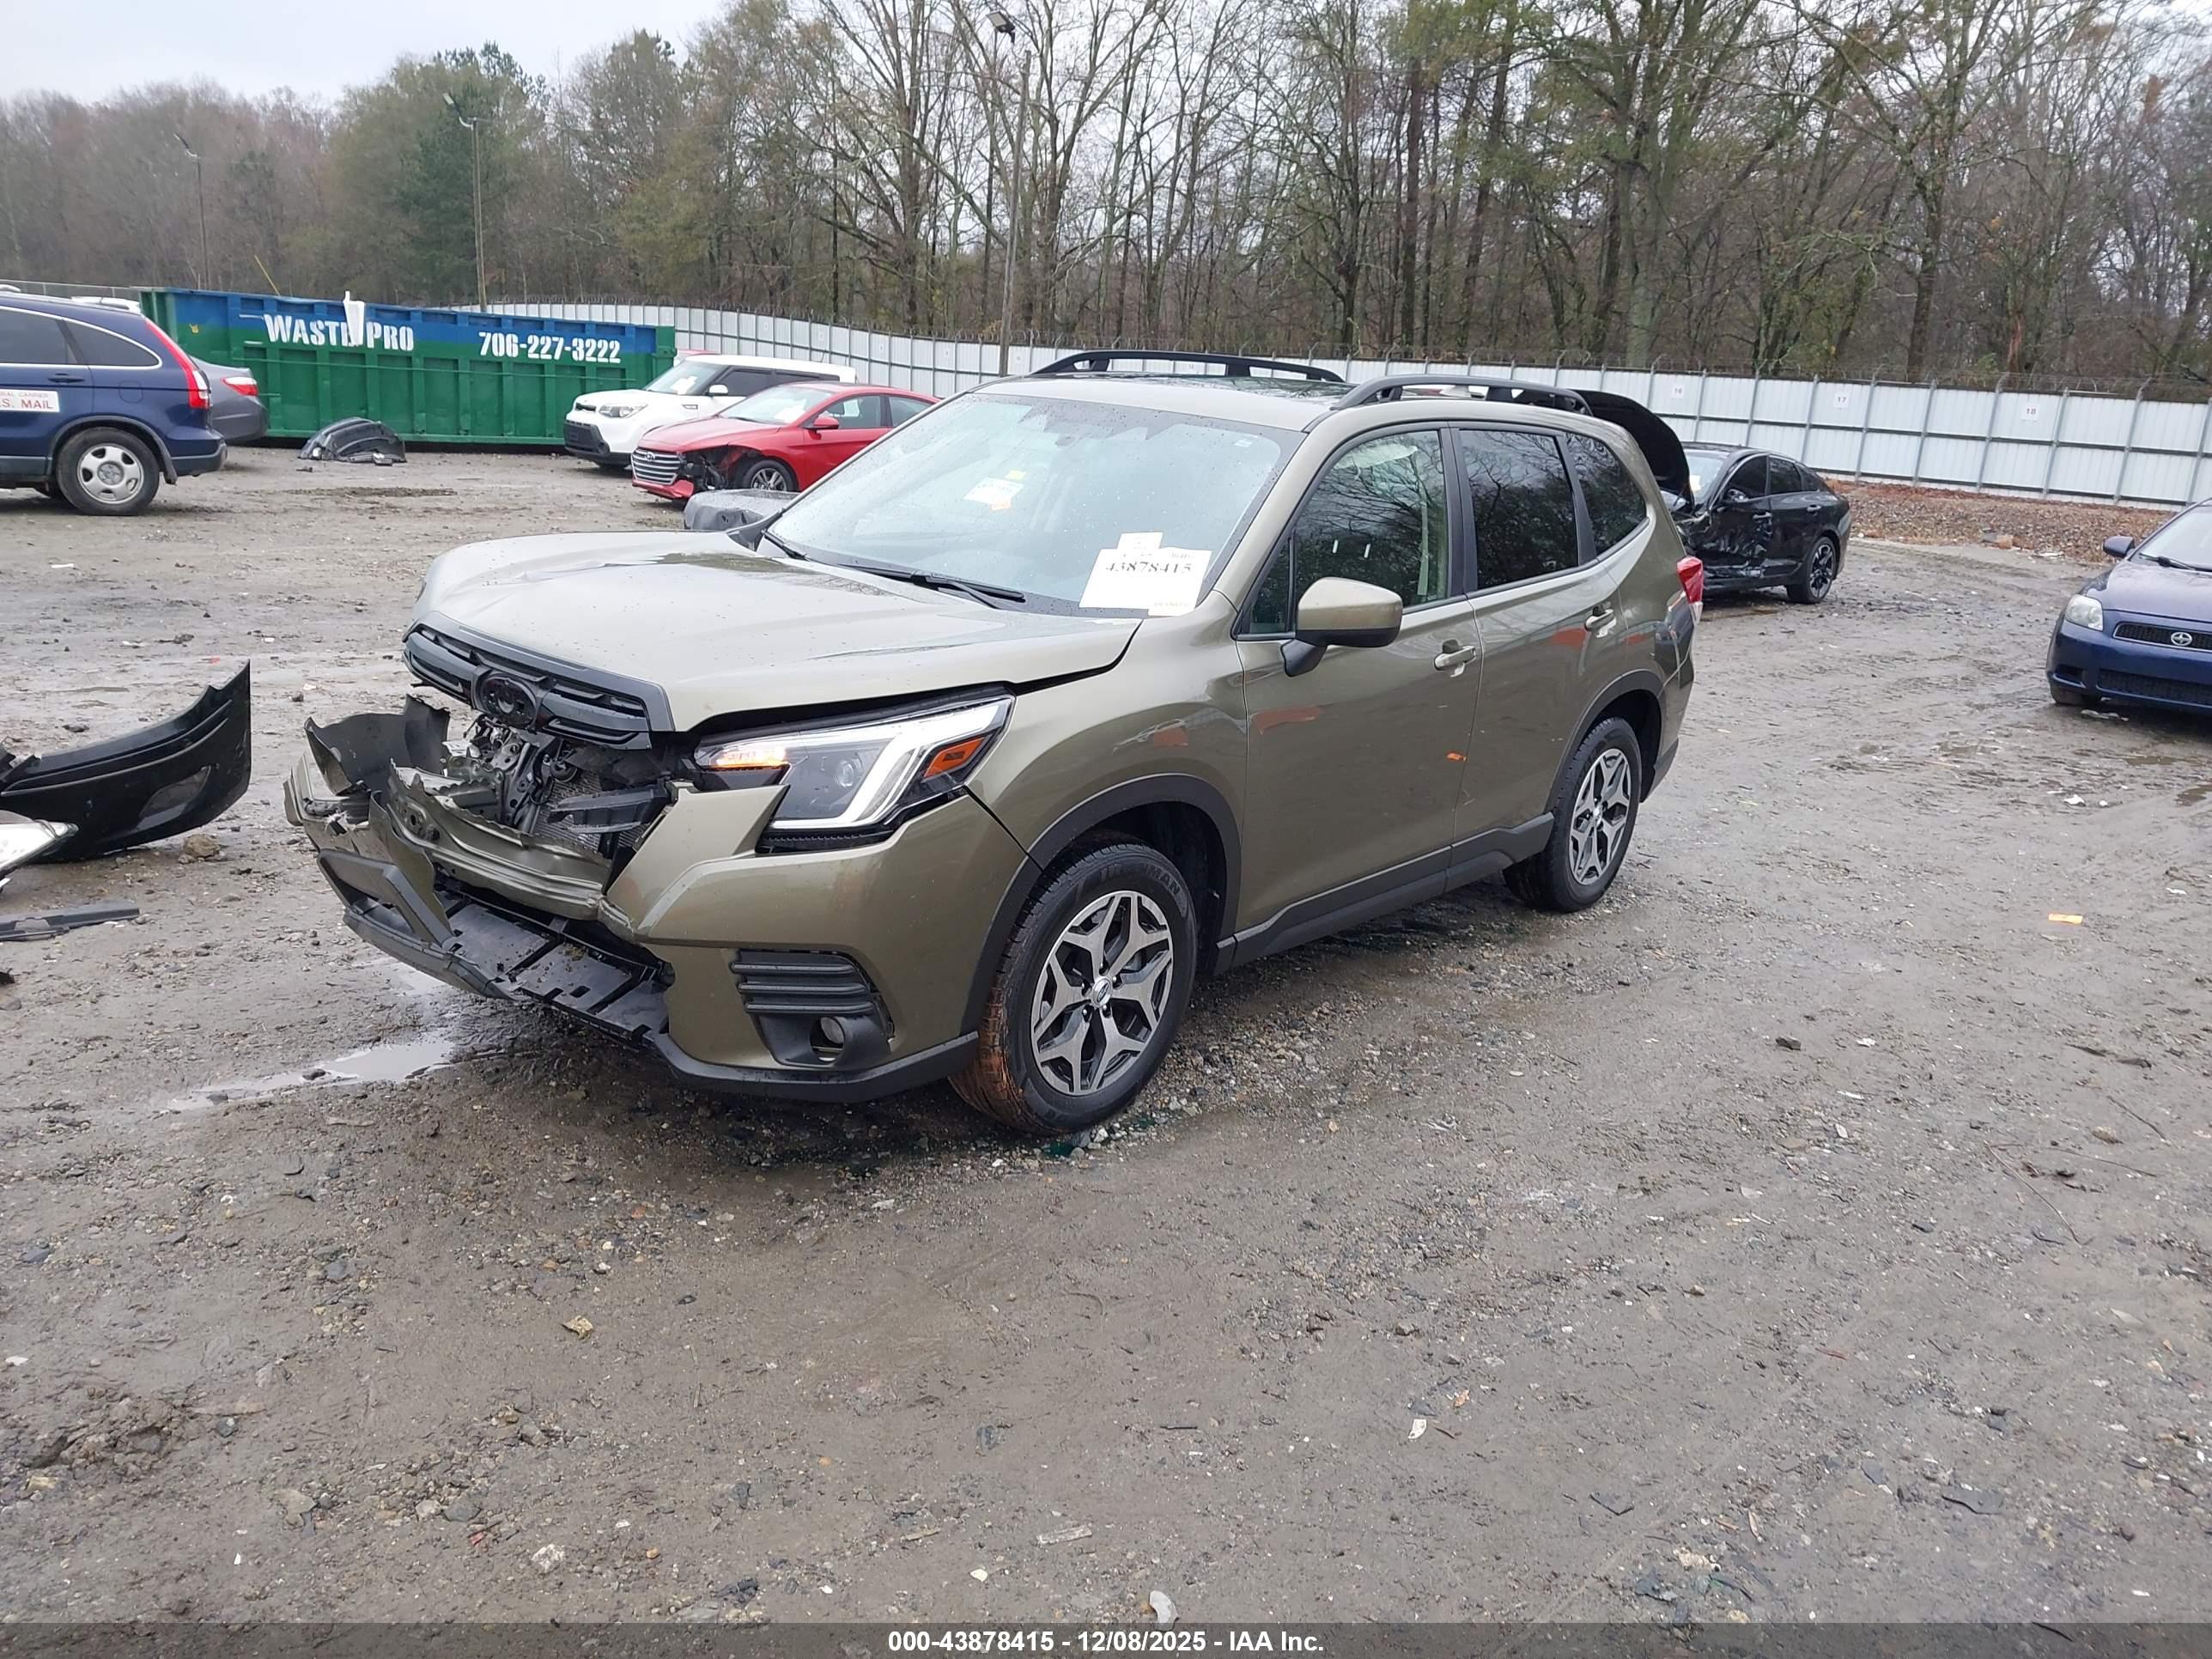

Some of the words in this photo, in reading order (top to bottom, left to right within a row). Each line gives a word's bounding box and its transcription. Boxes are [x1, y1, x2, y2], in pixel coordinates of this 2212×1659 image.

[366, 322, 414, 351] PRO
[479, 332, 621, 363] 706-227-3222
[0, 398, 15, 409] .S.
[21, 399, 53, 410] MAIL
